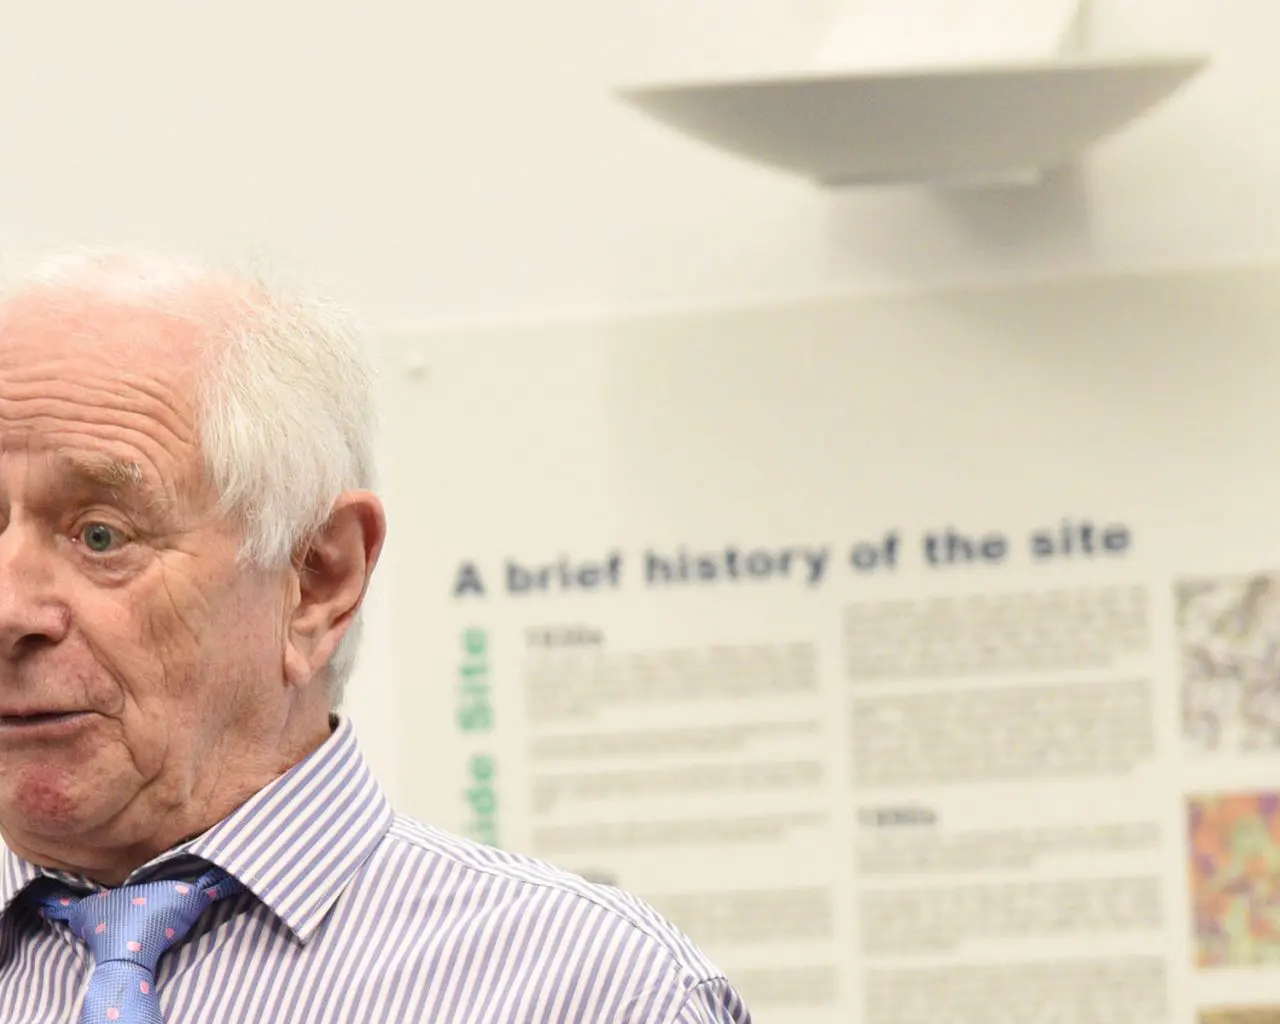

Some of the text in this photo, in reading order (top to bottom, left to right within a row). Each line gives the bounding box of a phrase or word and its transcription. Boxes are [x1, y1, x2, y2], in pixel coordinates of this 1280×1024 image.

[455, 518, 1133, 596] A brief history of the site
[457, 626, 494, 731] Site
